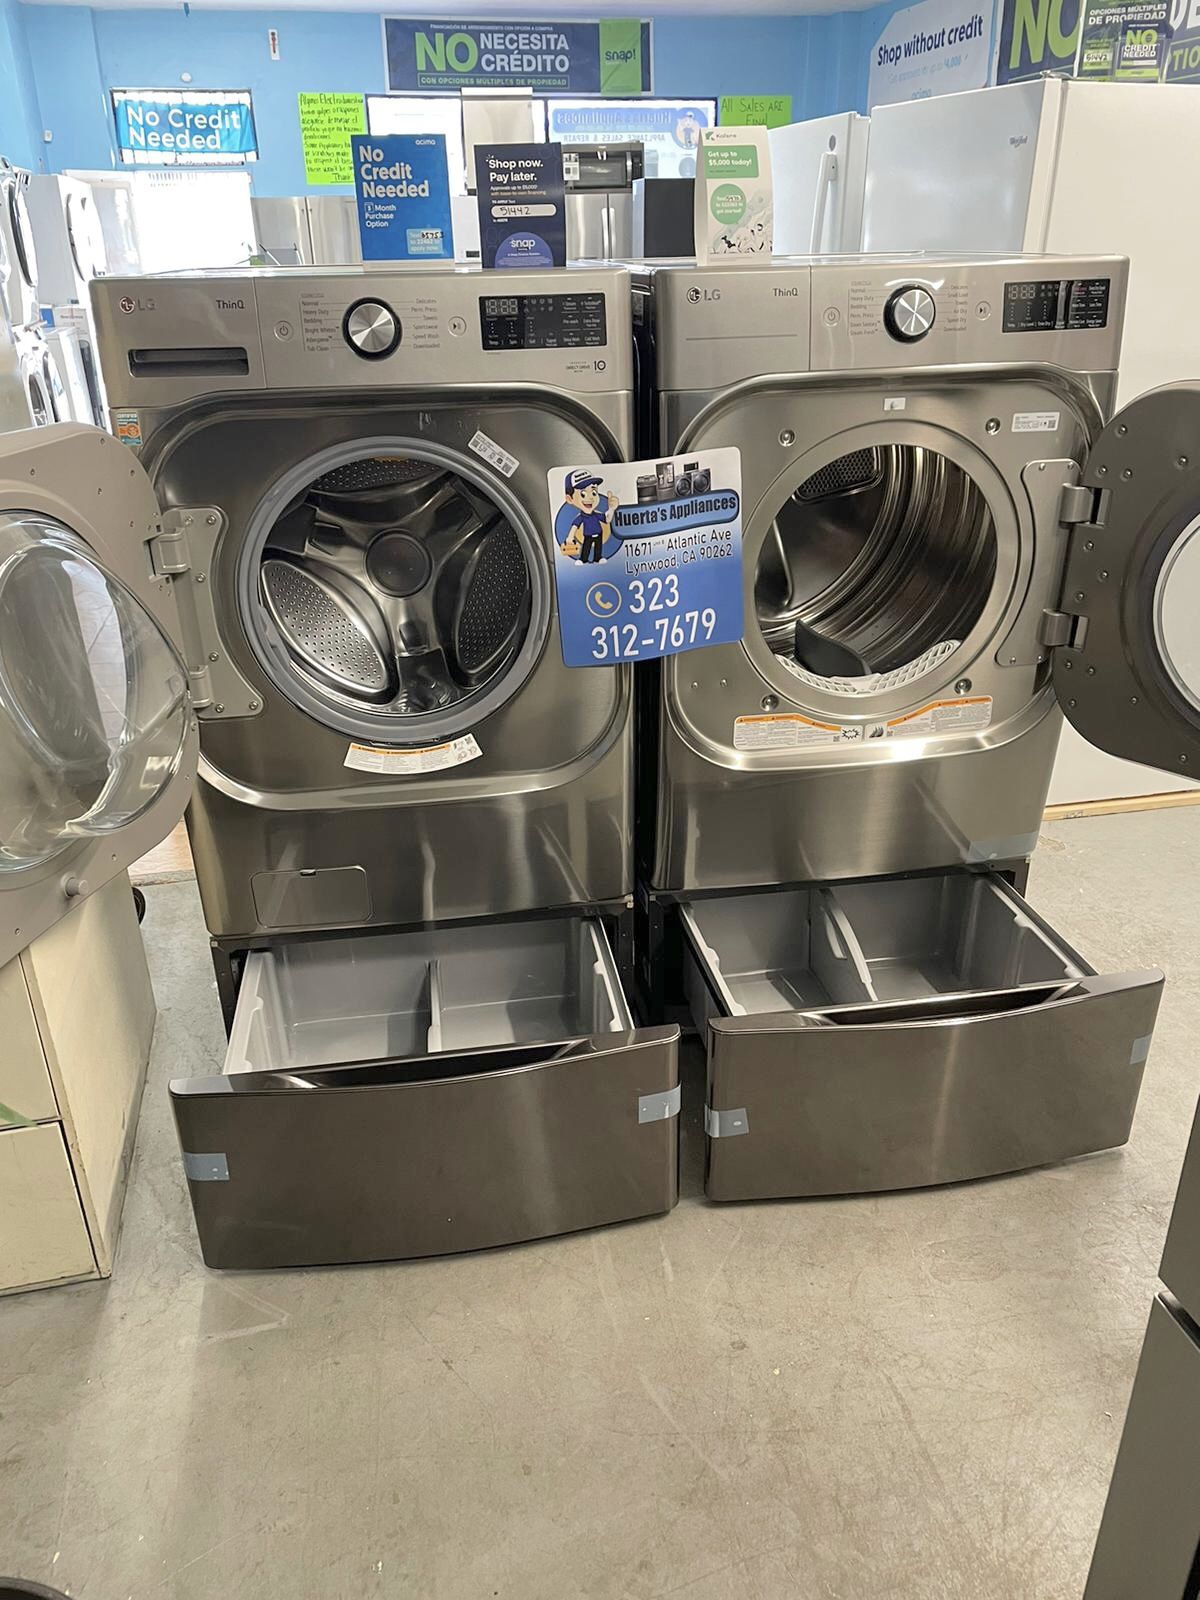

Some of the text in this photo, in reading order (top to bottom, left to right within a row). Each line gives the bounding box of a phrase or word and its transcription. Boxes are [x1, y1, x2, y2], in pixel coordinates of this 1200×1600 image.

[1088, 10, 1166, 26] DE PROPIEDAD
[1089, 7, 1127, 16] OPCIONES
[877, 14, 984, 66] Shop without credit
[1125, 29, 1158, 45] NO
[415, 32, 569, 73] NO NECESITA
[1122, 50, 1156, 58] NEEDED
[1124, 43, 1157, 52] CREDIT
[481, 50, 570, 73] CRÉDITO
[605, 48, 637, 63] snap!
[421, 76, 437, 85] CON
[438, 77, 475, 85] OPCIONES
[516, 78, 526, 86] DE
[527, 78, 567, 86] PROPIEDAD
[127, 105, 241, 129] No Credit
[129, 126, 221, 149] Needed
[359, 145, 384, 162] No
[489, 159, 544, 170] Shop now.
[708, 158, 752, 167] $5,000 today!
[361, 162, 413, 180] Credit
[489, 172, 537, 183] Pay later.
[362, 180, 429, 198] Needed
[375, 204, 397, 212] Month
[500, 207, 531, 216] 51442
[365, 212, 394, 220] Purchase
[365, 220, 389, 228] Option
[511, 238, 535, 250] snap
[773, 288, 798, 297] ThinQ
[216, 299, 245, 310] ThinQ
[614, 496, 736, 528] Huerta's Appliances
[624, 529, 732, 559] 11671 Atlantic Ave
[624, 543, 733, 576] Lynwood, CA 90262
[628, 574, 680, 615] 323
[591, 607, 717, 660] 312-7679
